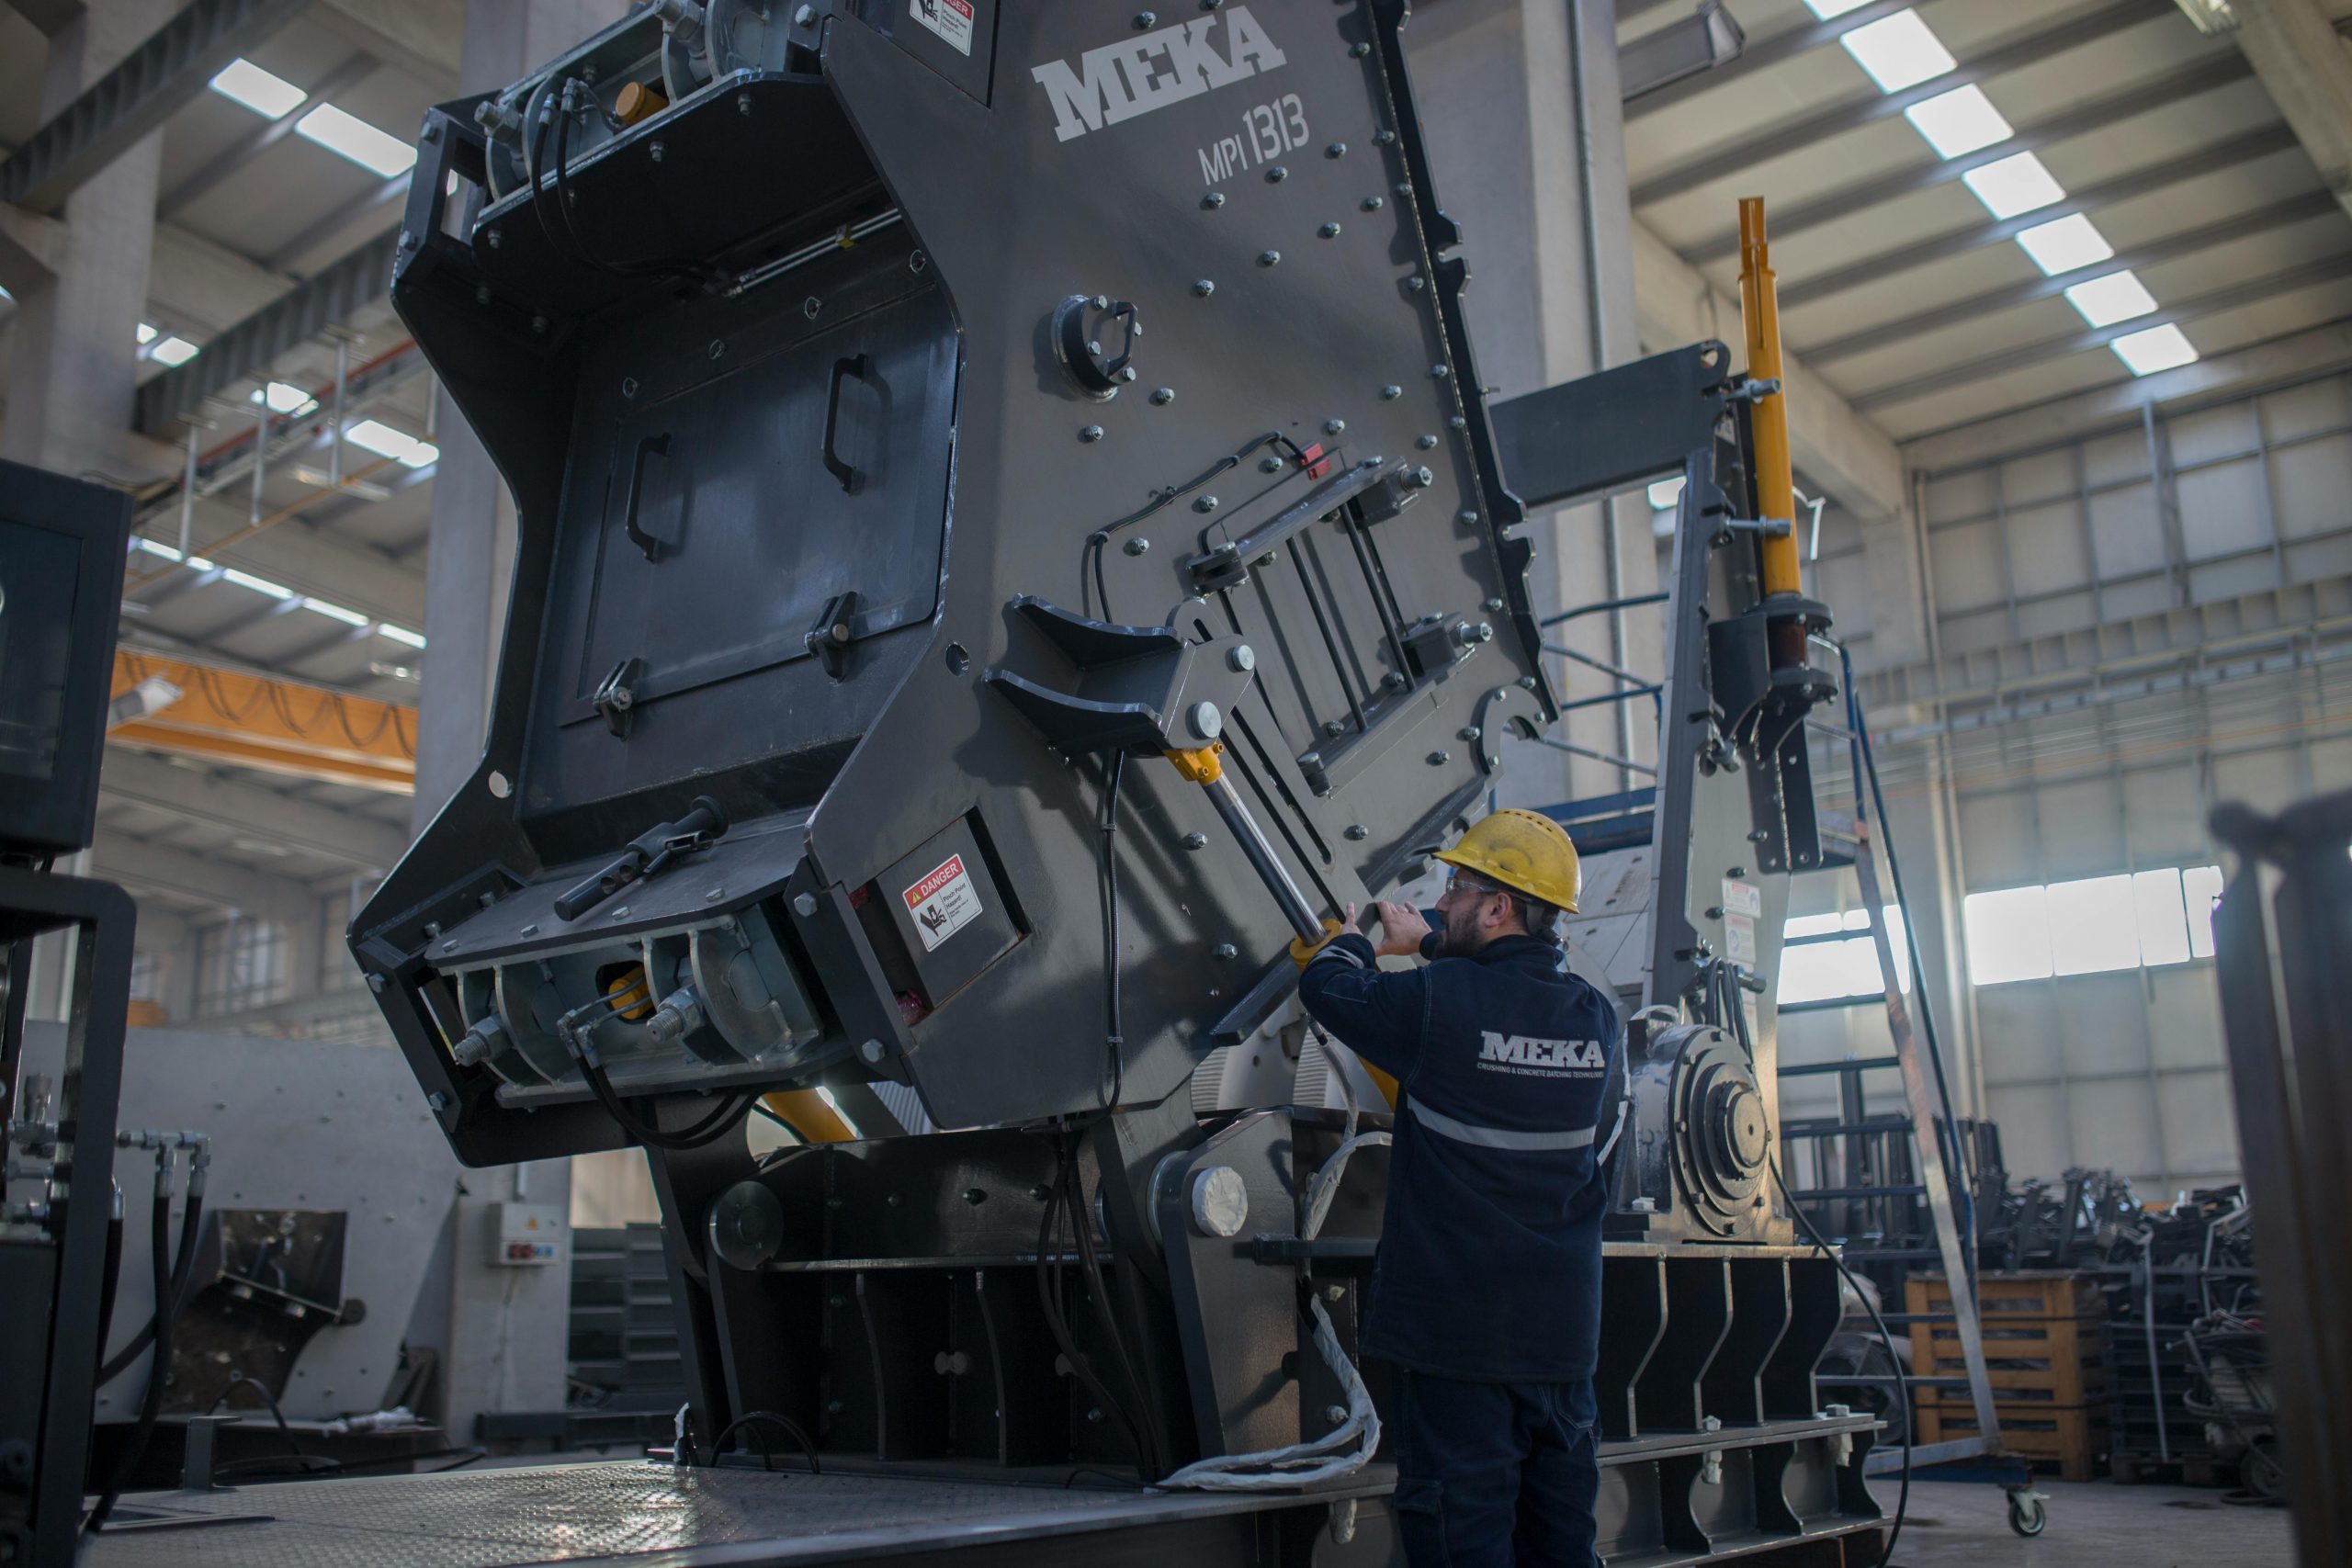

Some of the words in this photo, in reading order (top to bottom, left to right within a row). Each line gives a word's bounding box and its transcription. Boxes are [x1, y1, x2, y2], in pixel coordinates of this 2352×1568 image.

[944, 0, 967, 16] GER
[1031, 5, 1287, 142] MEKA
[1197, 133, 1249, 186] MPI
[1242, 93, 1310, 164] 1313
[921, 863, 958, 896] DANGER
[943, 891, 955, 902] Pinch
[954, 883, 966, 894] Point
[1479, 1031, 1605, 1067] MEKA
[1477, 1062, 1510, 1073] CRUSHING
[1517, 1067, 1547, 1077] CONCRETE
[1546, 1069, 1572, 1078] BATCHING
